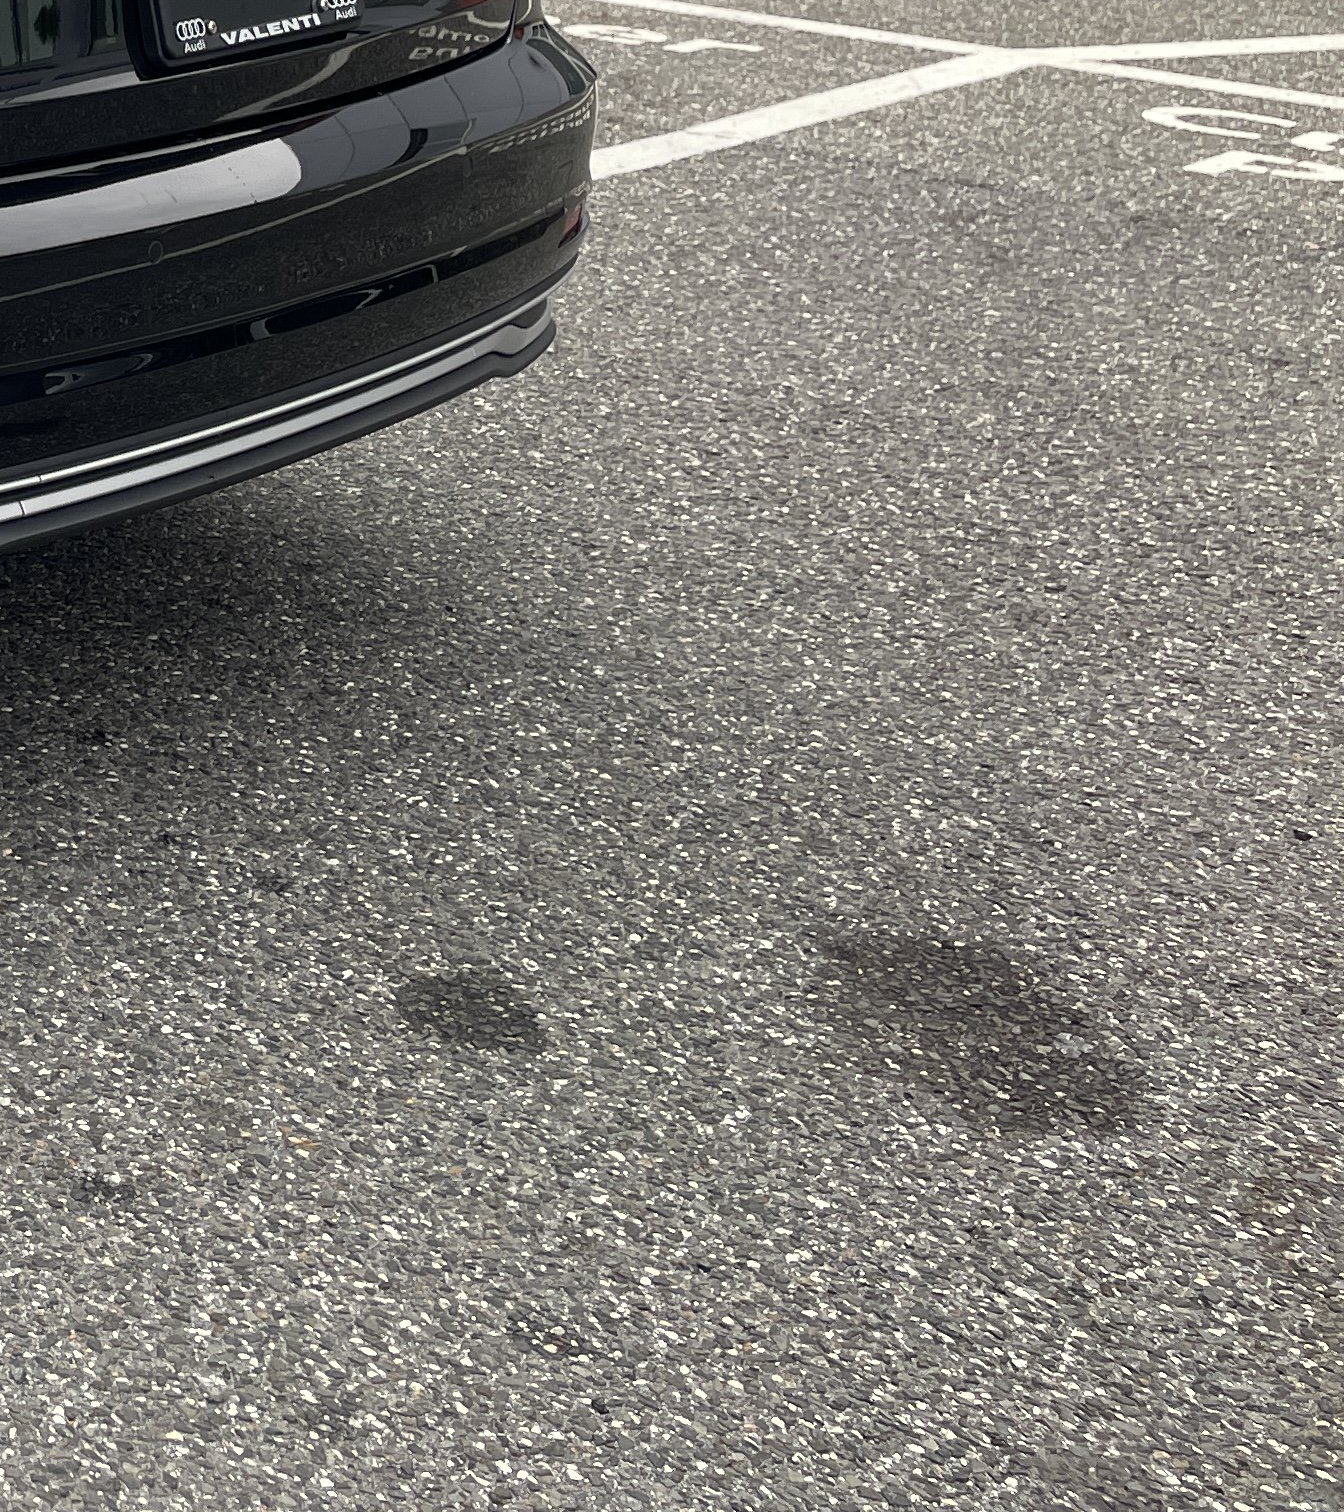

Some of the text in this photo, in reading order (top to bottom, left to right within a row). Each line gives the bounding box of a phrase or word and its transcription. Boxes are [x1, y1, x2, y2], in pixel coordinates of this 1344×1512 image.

[335, 6, 358, 21] Audi
[220, 13, 322, 45] VALENTI
[184, 39, 207, 54] Audi
